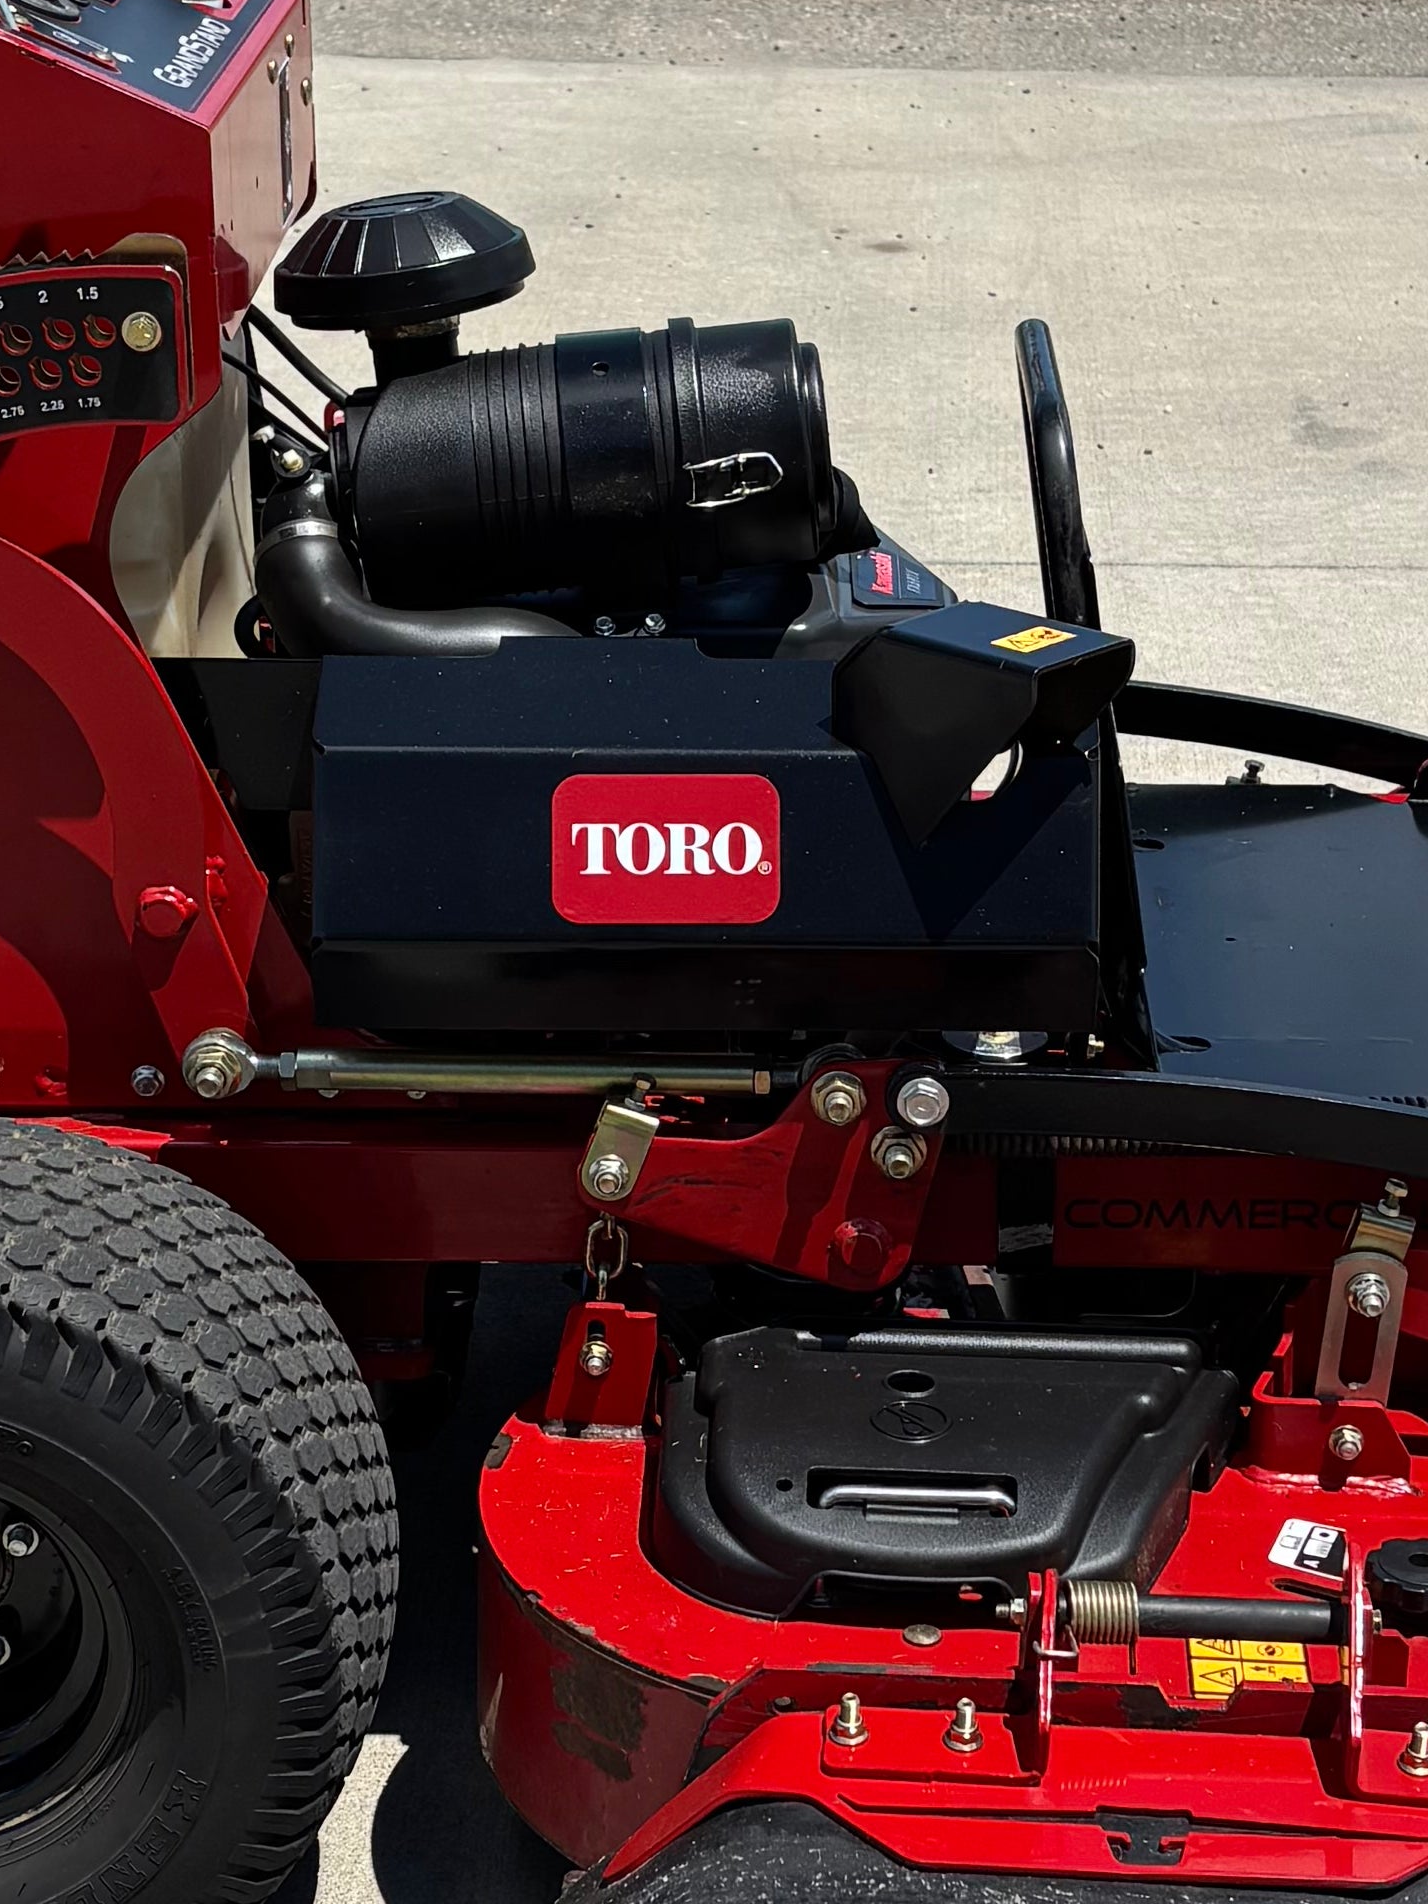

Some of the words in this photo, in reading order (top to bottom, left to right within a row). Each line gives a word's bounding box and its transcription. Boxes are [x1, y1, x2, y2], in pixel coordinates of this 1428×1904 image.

[37, 289, 49, 304] 2
[75, 285, 99, 302] 1.5
[0, 402, 25, 420] 2.75
[39, 397, 65, 413] 2.25
[76, 395, 103, 411] 1.75
